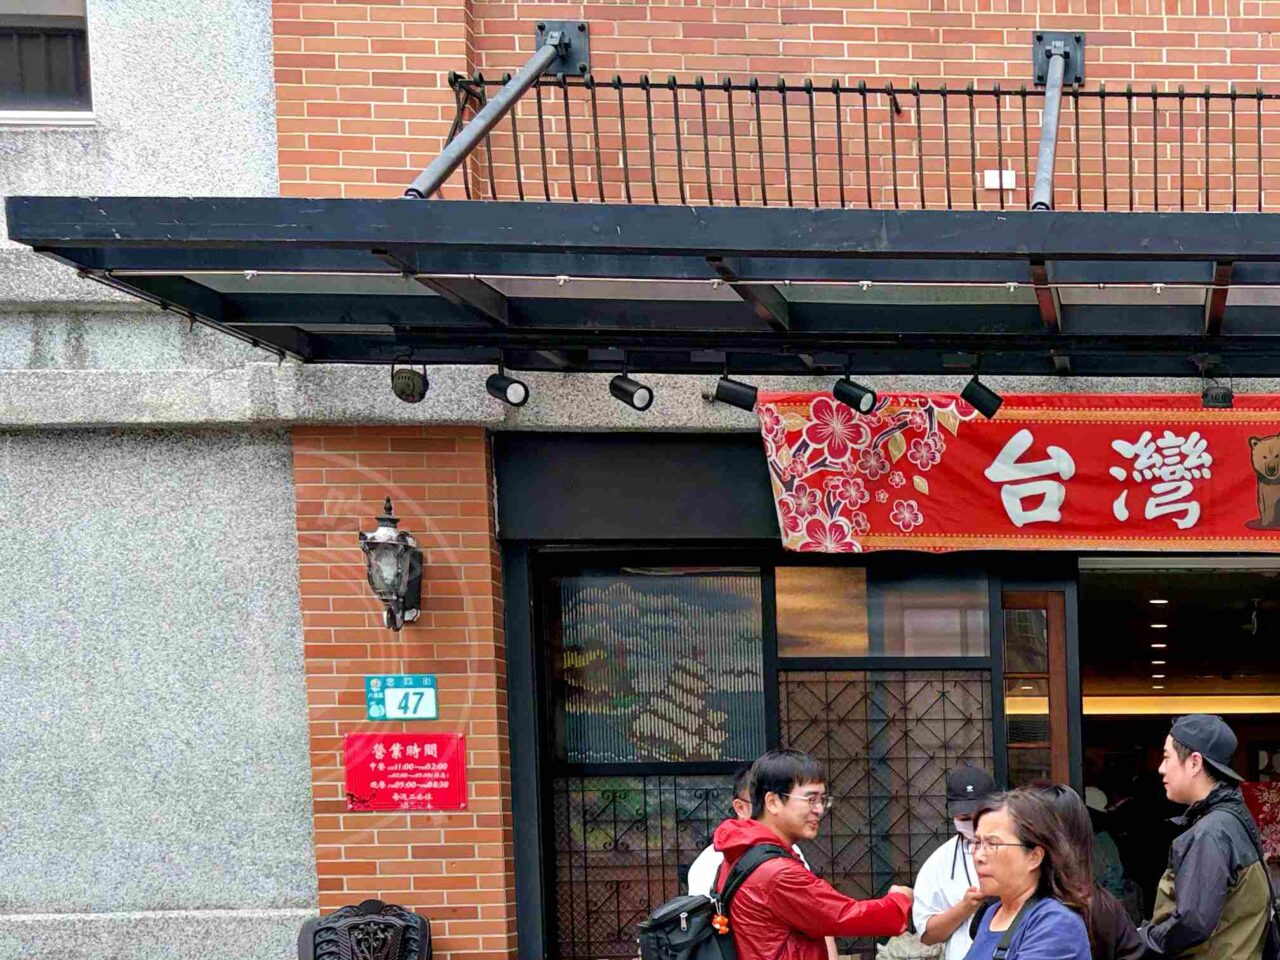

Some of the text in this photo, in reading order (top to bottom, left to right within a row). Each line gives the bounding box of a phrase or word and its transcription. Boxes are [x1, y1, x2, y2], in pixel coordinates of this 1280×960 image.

[984, 429, 1213, 530] 台灣
[397, 692, 425, 715] 47
[372, 742, 438, 760] 營業時間
